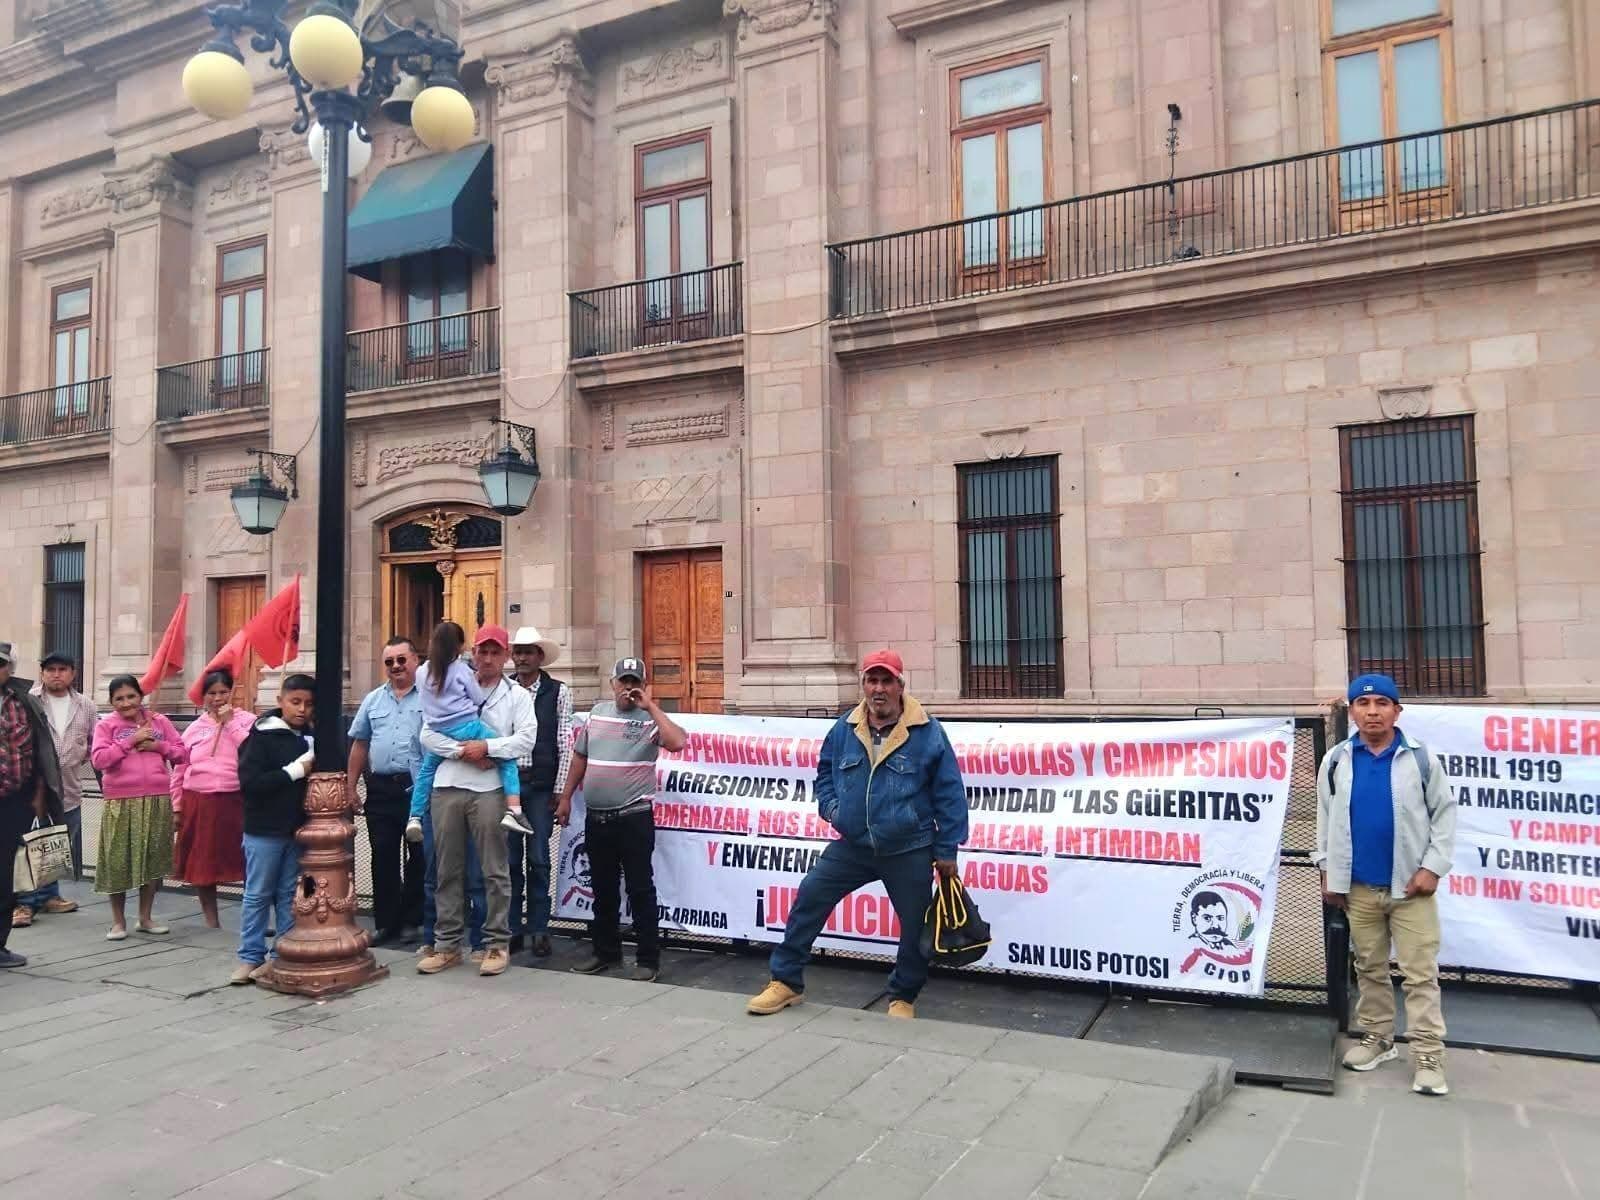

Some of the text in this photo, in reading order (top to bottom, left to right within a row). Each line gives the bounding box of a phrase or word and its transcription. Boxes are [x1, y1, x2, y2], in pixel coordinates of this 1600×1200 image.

[1484, 715, 1600, 756] GENER
[660, 732, 793, 767] EPENDIENTE
[954, 738, 1075, 776] GRÍCOLAS
[1080, 742, 1096, 776] Y
[1103, 740, 1287, 780] CAMPESINOS
[1506, 758, 1561, 783] 1919
[666, 770, 788, 800] AGRESIONES
[792, 779, 806, 802] A
[965, 786, 1056, 813] UNIDAD
[757, 809, 799, 836] NOS
[962, 822, 1048, 855] ALEAN,
[1056, 826, 1200, 862] INTIMIDAN
[1510, 819, 1522, 840] Y
[707, 841, 719, 865] Y
[963, 861, 1049, 893] AGUAS
[1478, 847, 1490, 867] Y
[1449, 874, 1600, 909] NO HAY SOLUC
[672, 907, 728, 930] ARRIAGA
[1008, 942, 1169, 979] SAN LUIS POTOSI
